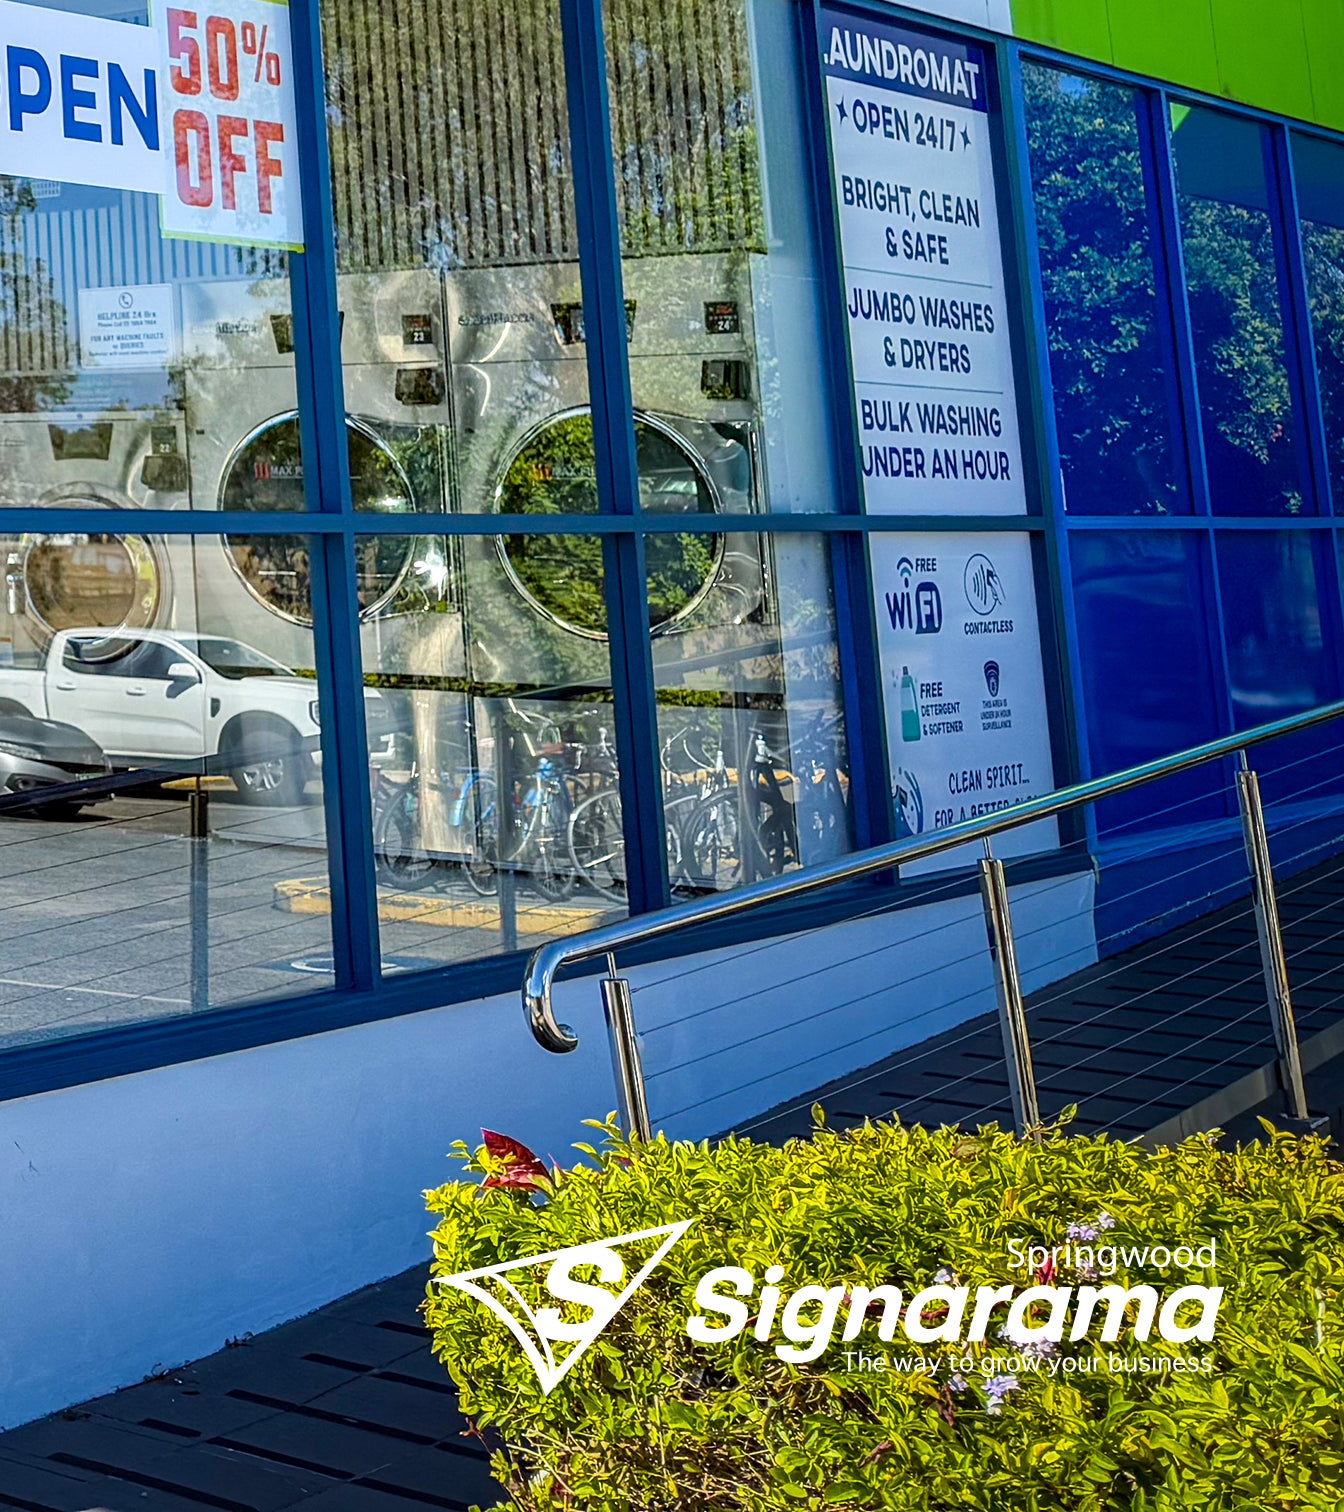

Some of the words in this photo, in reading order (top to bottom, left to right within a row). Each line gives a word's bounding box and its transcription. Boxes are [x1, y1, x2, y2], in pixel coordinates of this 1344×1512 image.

[166, 6, 281, 102] 50%
[823, 26, 980, 101] AUNDROMAT
[852, 97, 912, 145] OPEN
[915, 111, 957, 153] 24/7
[173, 109, 285, 215] OFF
[841, 174, 918, 223] BRIGHT,
[919, 189, 981, 229] CLEAN
[885, 227, 899, 258] &
[902, 231, 950, 266] SAFE
[848, 287, 916, 326] JUMBO
[919, 296, 995, 334] WASHES
[883, 335, 897, 367] &
[900, 338, 971, 375] DRYERS
[861, 399, 913, 434] BULK
[917, 404, 1002, 437] WASHING
[859, 445, 927, 480] UNDER
[930, 449, 960, 479] AN
[962, 449, 1011, 481] HOUR
[915, 557, 937, 572] FREE
[964, 619, 1014, 635] CONTACTLESS
[920, 682, 943, 699] FREE
[921, 702, 960, 717] DETERGENT
[923, 724, 928, 736] &
[929, 720, 964, 735] SOFTENER
[948, 770, 982, 795] CLEAN
[935, 808, 954, 828] FOR
